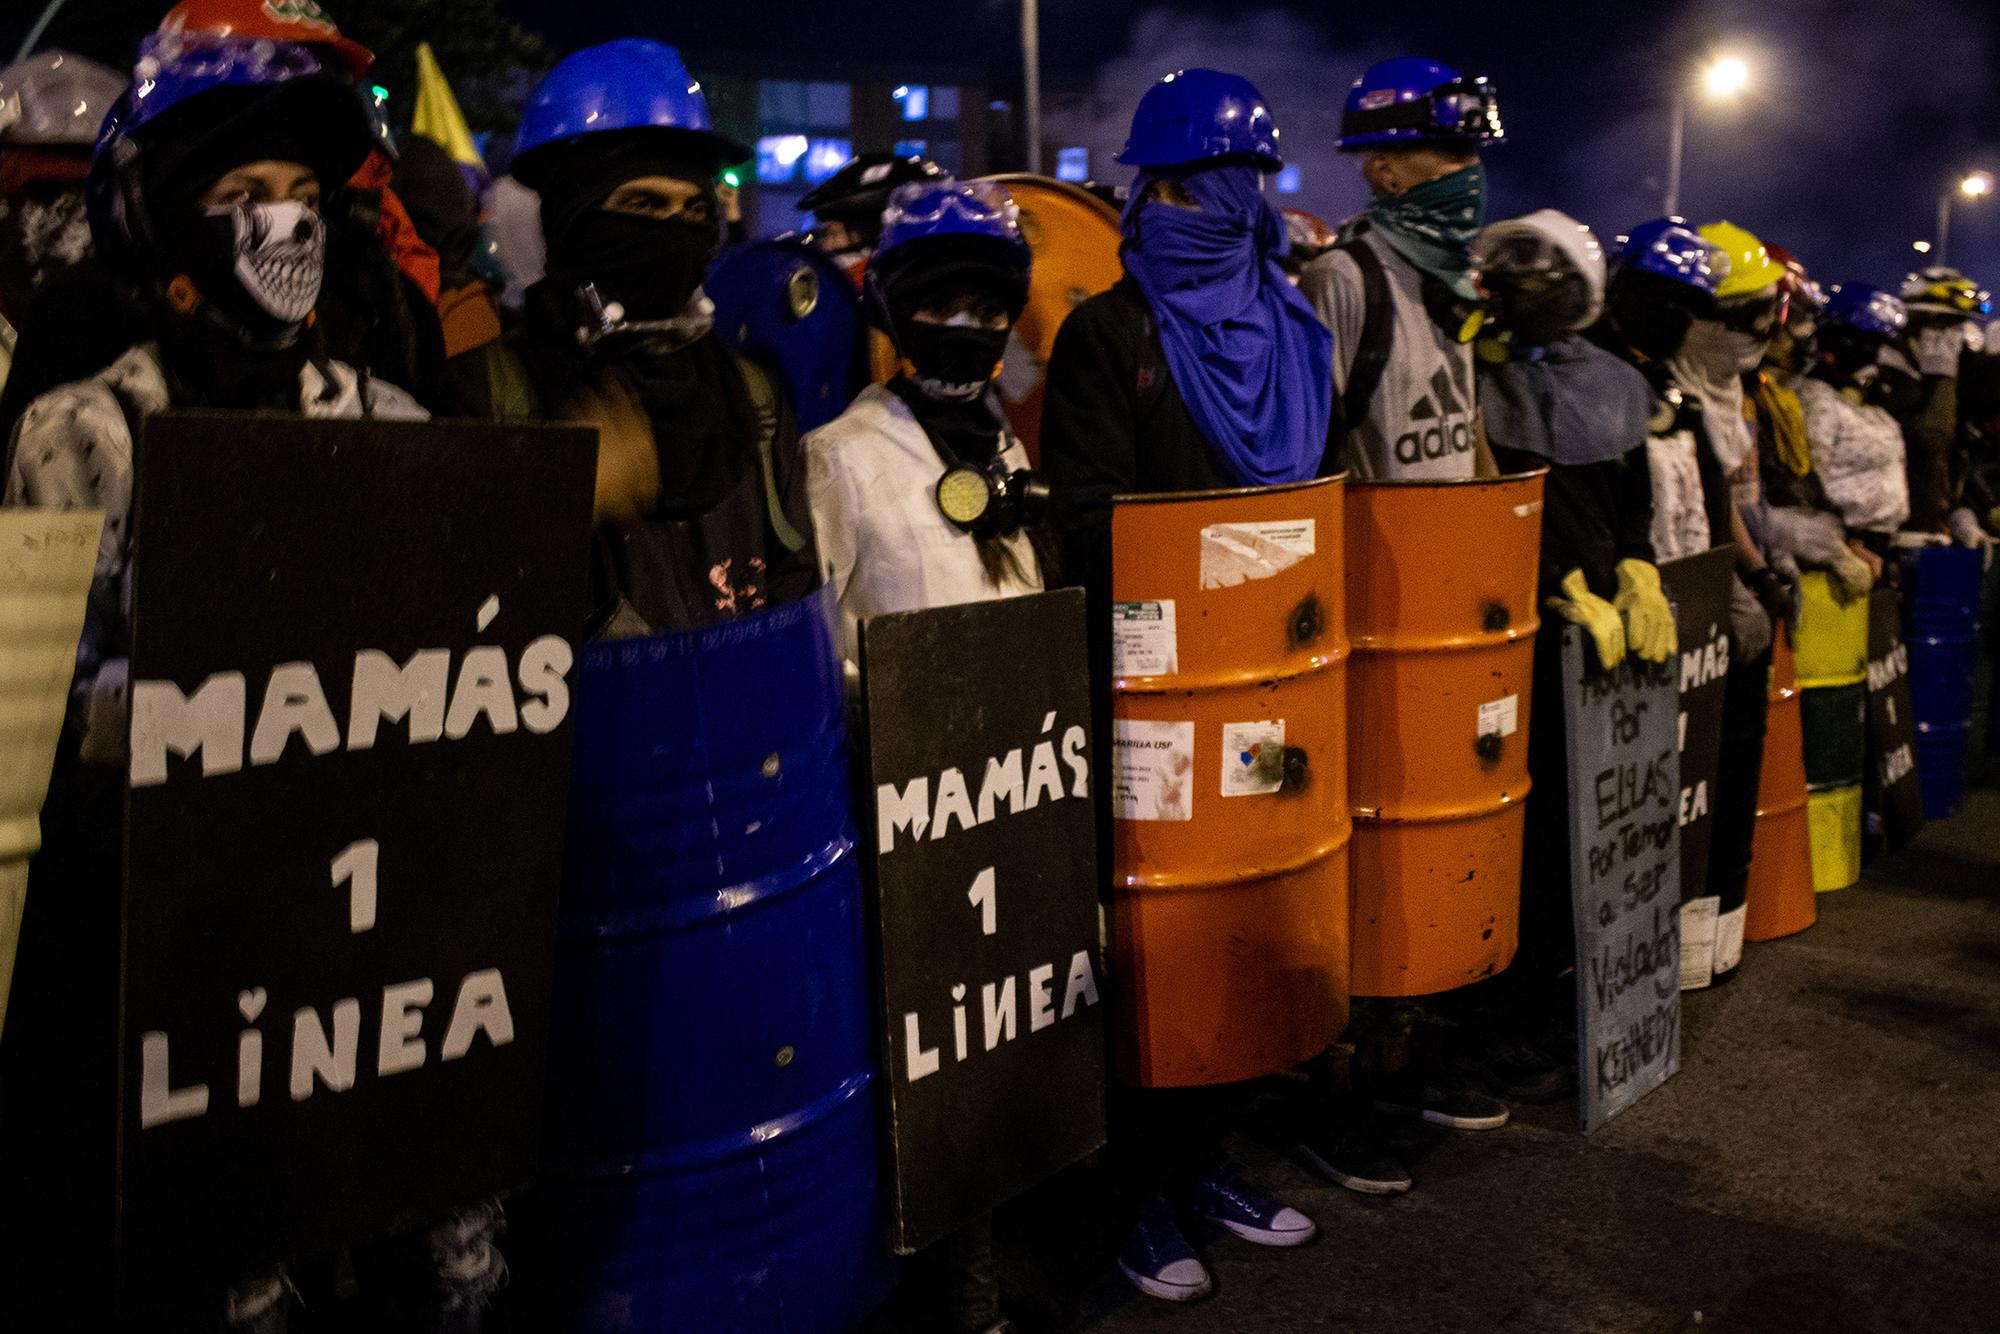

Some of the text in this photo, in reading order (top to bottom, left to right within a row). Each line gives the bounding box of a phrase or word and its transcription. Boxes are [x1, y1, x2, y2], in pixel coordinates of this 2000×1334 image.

[130, 594, 573, 788] MAMÁS
[1679, 623, 1729, 693] MÁS
[877, 711, 1089, 855] MAMÁS
[331, 839, 379, 934] 1
[967, 866, 997, 935] 1
